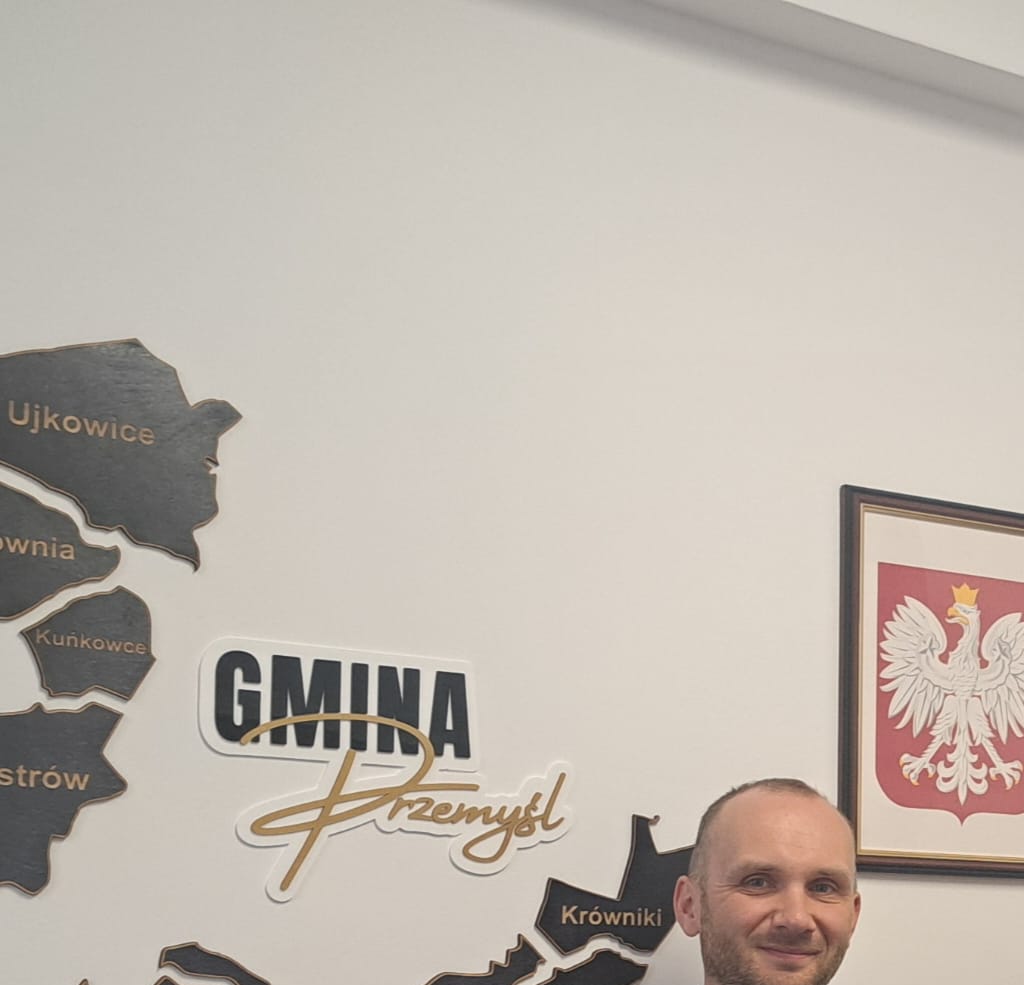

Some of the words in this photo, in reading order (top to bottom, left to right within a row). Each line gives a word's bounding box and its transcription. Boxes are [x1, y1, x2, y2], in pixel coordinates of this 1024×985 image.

[8, 400, 156, 445] Ujkowice
[0, 536, 75, 560] wnia
[35, 628, 147, 654] Kuńkowce
[214, 650, 471, 759] GMINA
[240, 712, 566, 891] Przemyśl
[561, 904, 662, 926] Krówniki
